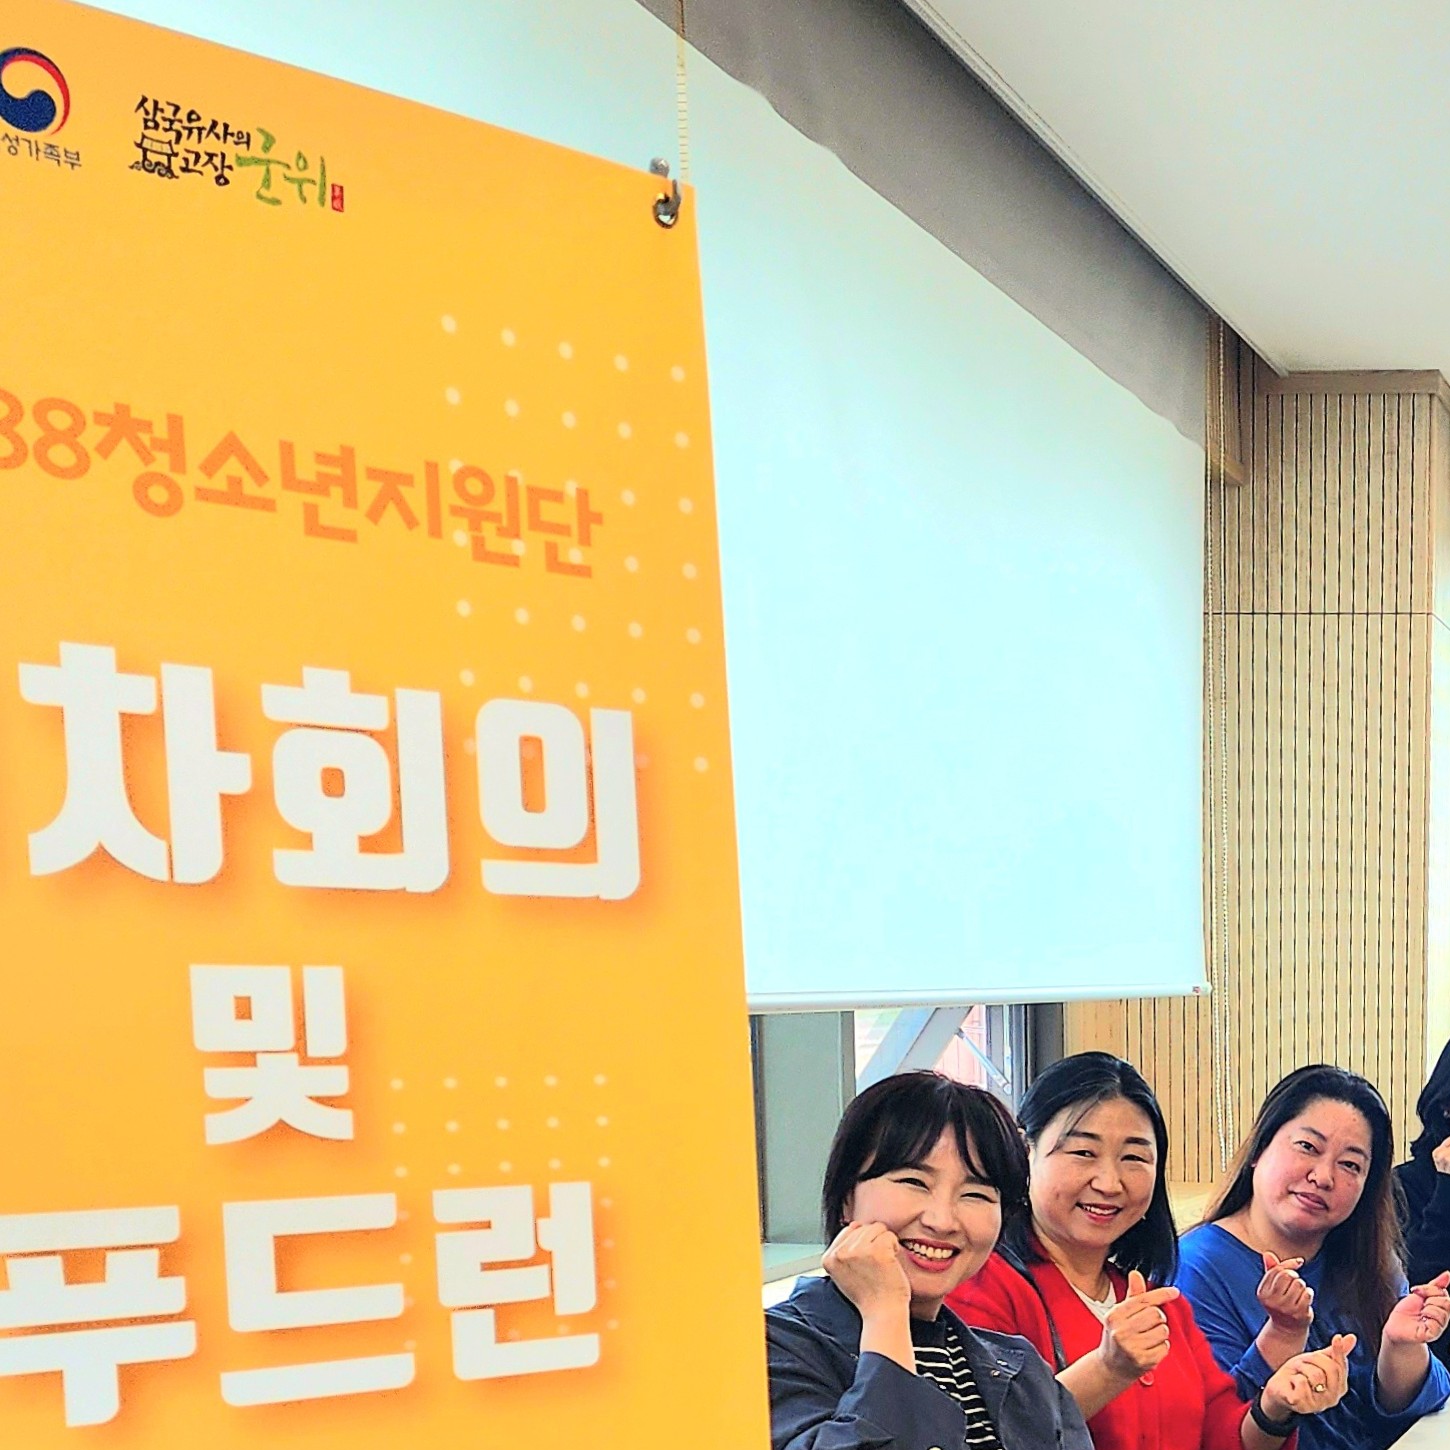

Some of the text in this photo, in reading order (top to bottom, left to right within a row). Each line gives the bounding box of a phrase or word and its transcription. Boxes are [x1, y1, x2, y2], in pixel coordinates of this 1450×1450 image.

[1, 133, 82, 171] 성가족부
[134, 94, 251, 151] 삼국유사의
[179, 149, 234, 187] 고장
[235, 127, 326, 207] 군위
[18, 641, 642, 900] 차회의
[189, 963, 355, 1146] 및
[0, 1181, 600, 1428] 푸드런
